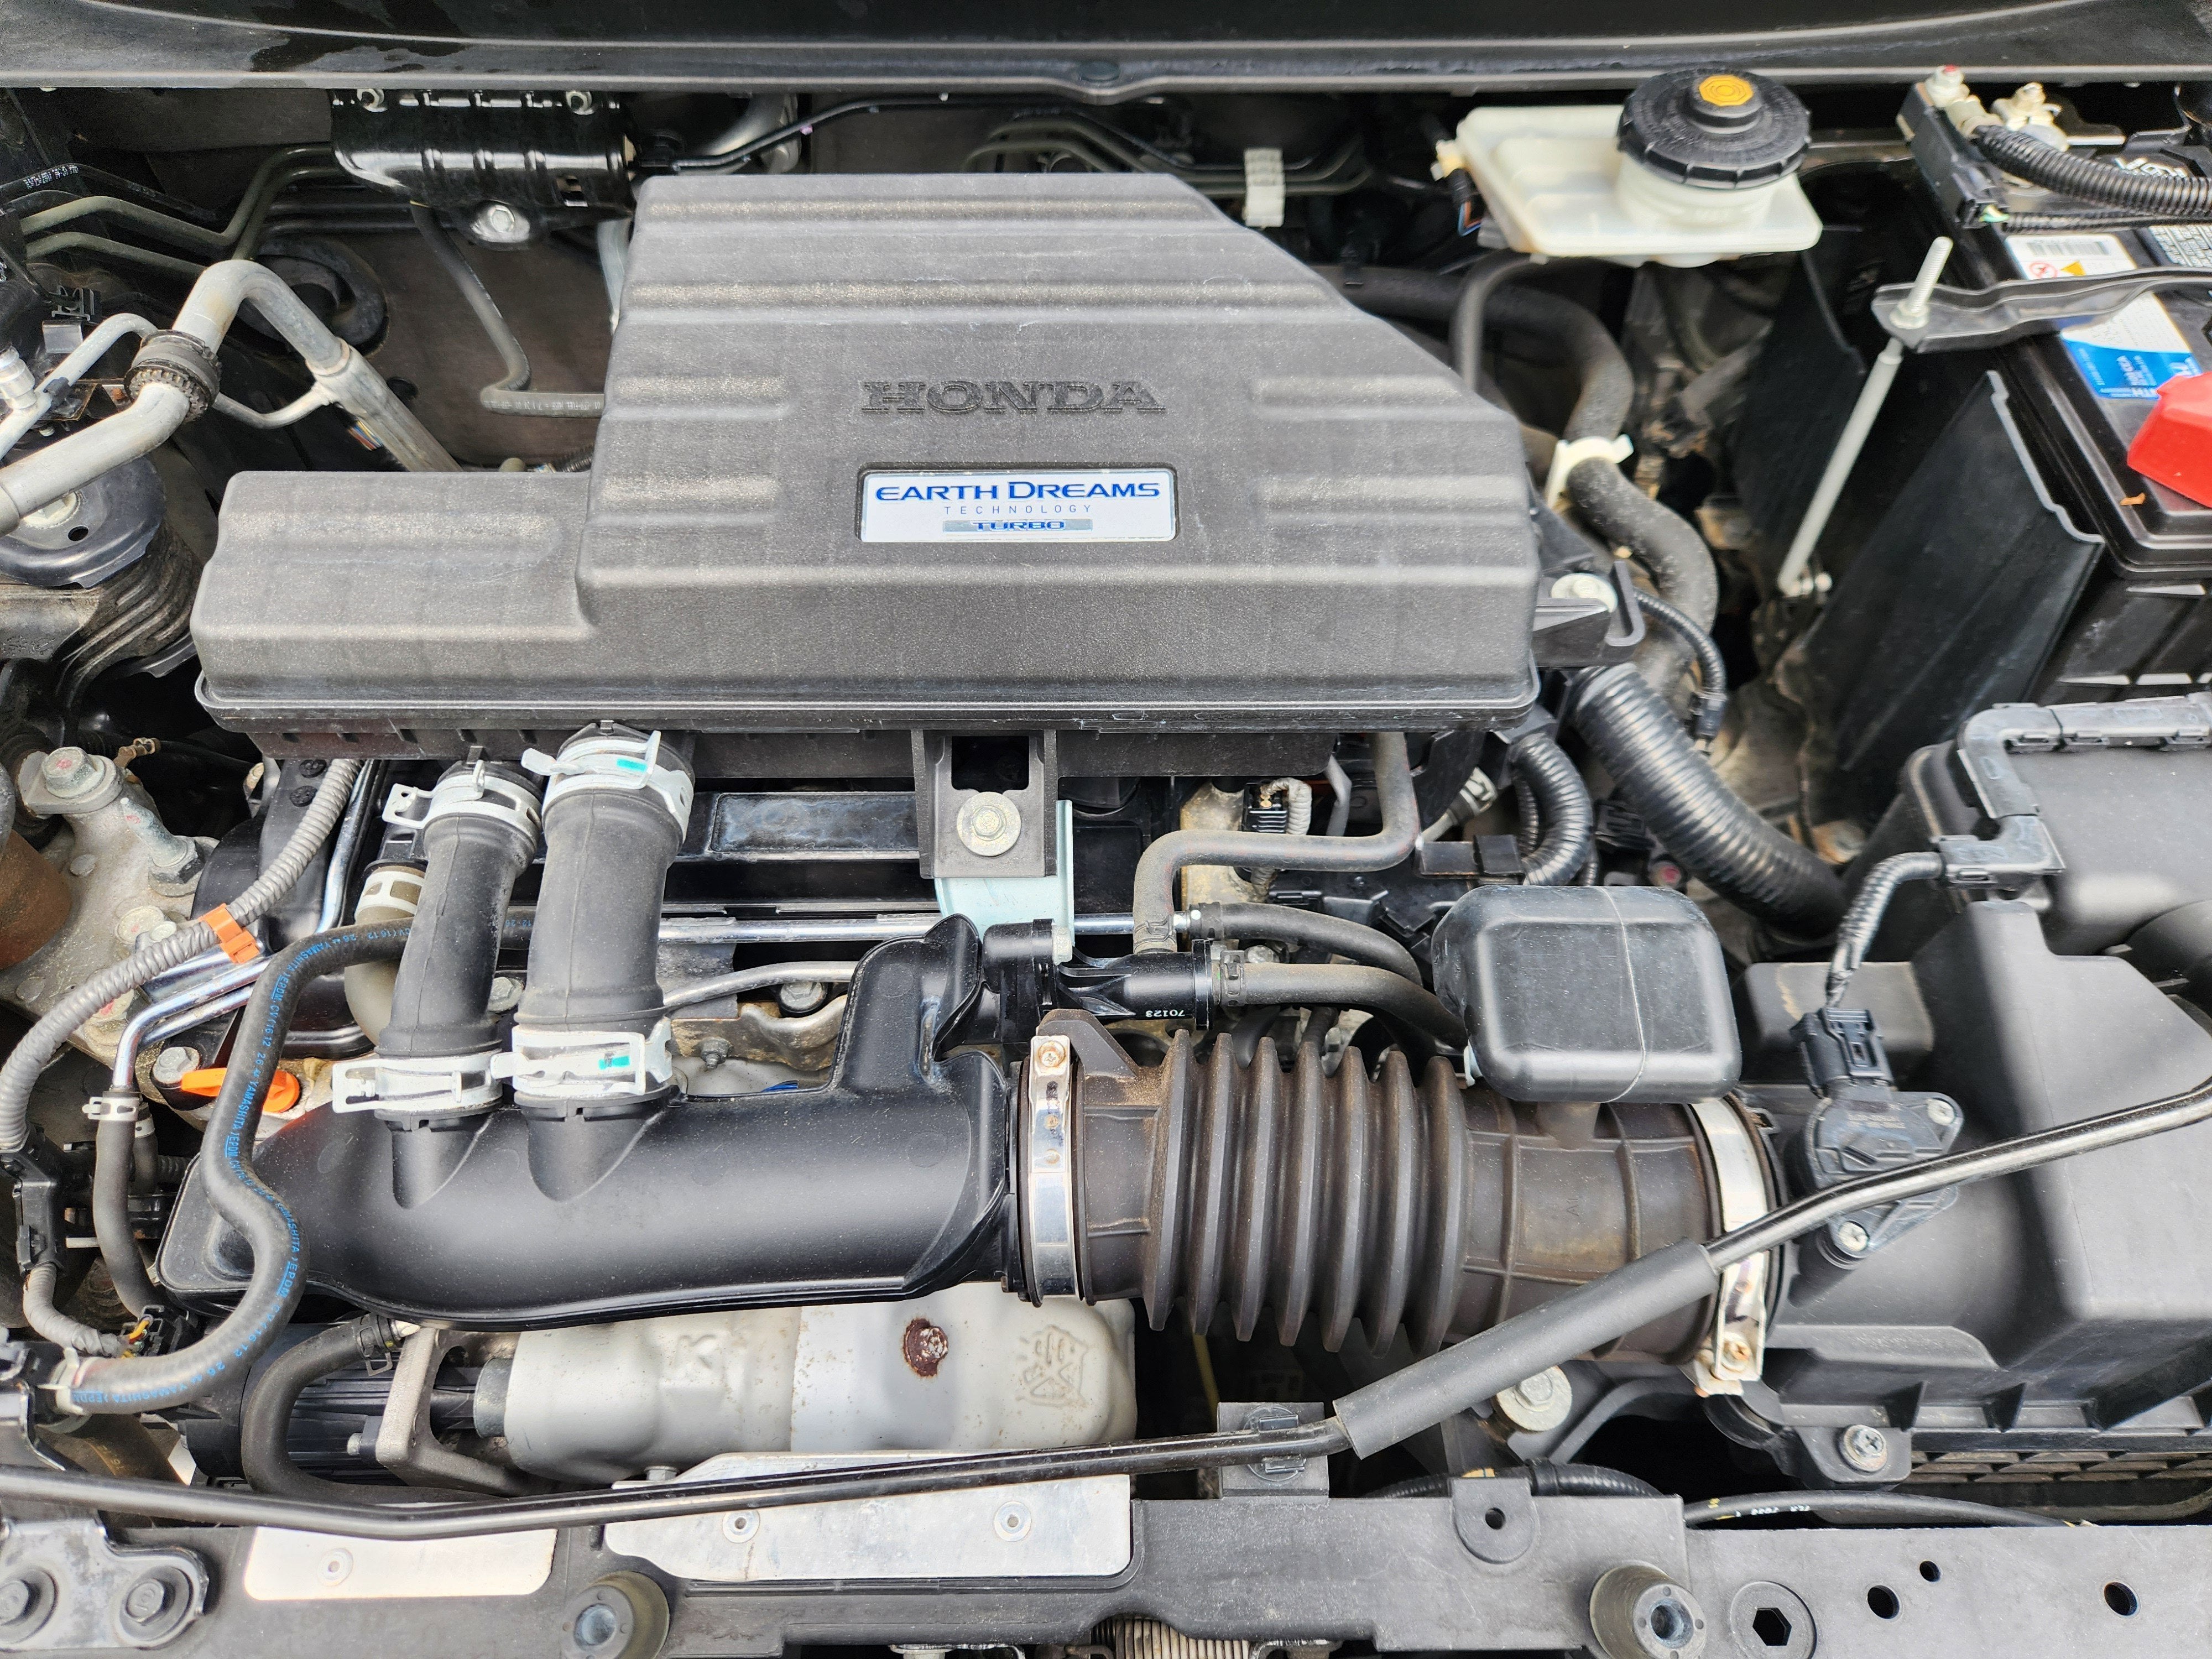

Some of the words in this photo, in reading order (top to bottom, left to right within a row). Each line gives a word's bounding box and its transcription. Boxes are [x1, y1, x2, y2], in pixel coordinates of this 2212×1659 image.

[861, 380, 1166, 414] HONDA
[875, 484, 998, 502] EARTH
[1008, 481, 1160, 502] DREAMS
[944, 504, 1092, 514] TECHNOLOGY
[971, 520, 1065, 531] TURBO
[287, 941, 331, 972] YAMASHITA
[1145, 1009, 1186, 1018] 70123
[232, 1081, 259, 1130] YAMASHITA
